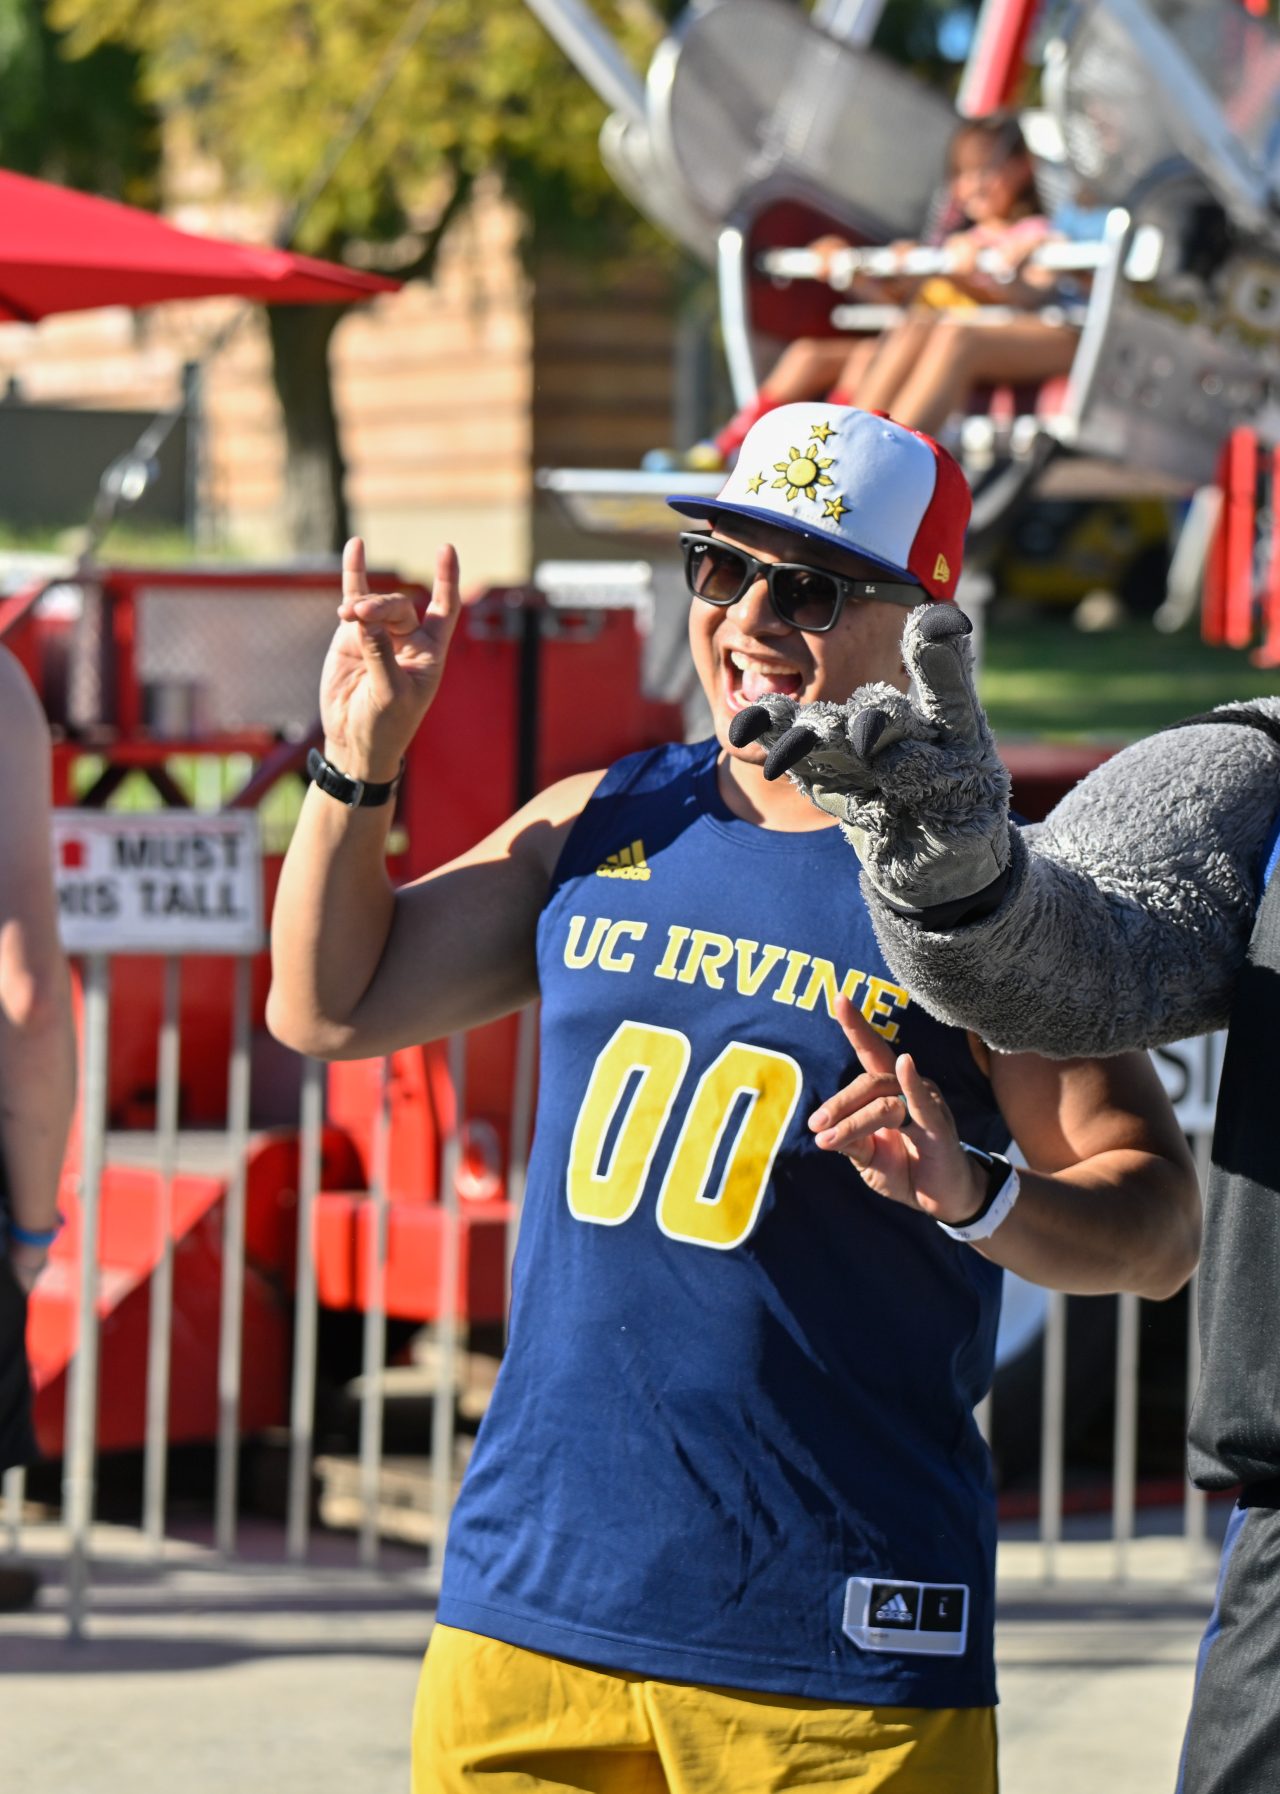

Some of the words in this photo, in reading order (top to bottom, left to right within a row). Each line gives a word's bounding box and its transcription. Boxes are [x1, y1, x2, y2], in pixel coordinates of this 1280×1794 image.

[115, 835, 240, 869] MUST
[596, 864, 651, 881] adidas
[140, 880, 244, 916] TALL
[564, 915, 647, 973] UC
[654, 925, 909, 1040] IRVINE
[566, 1019, 803, 1250] 00
